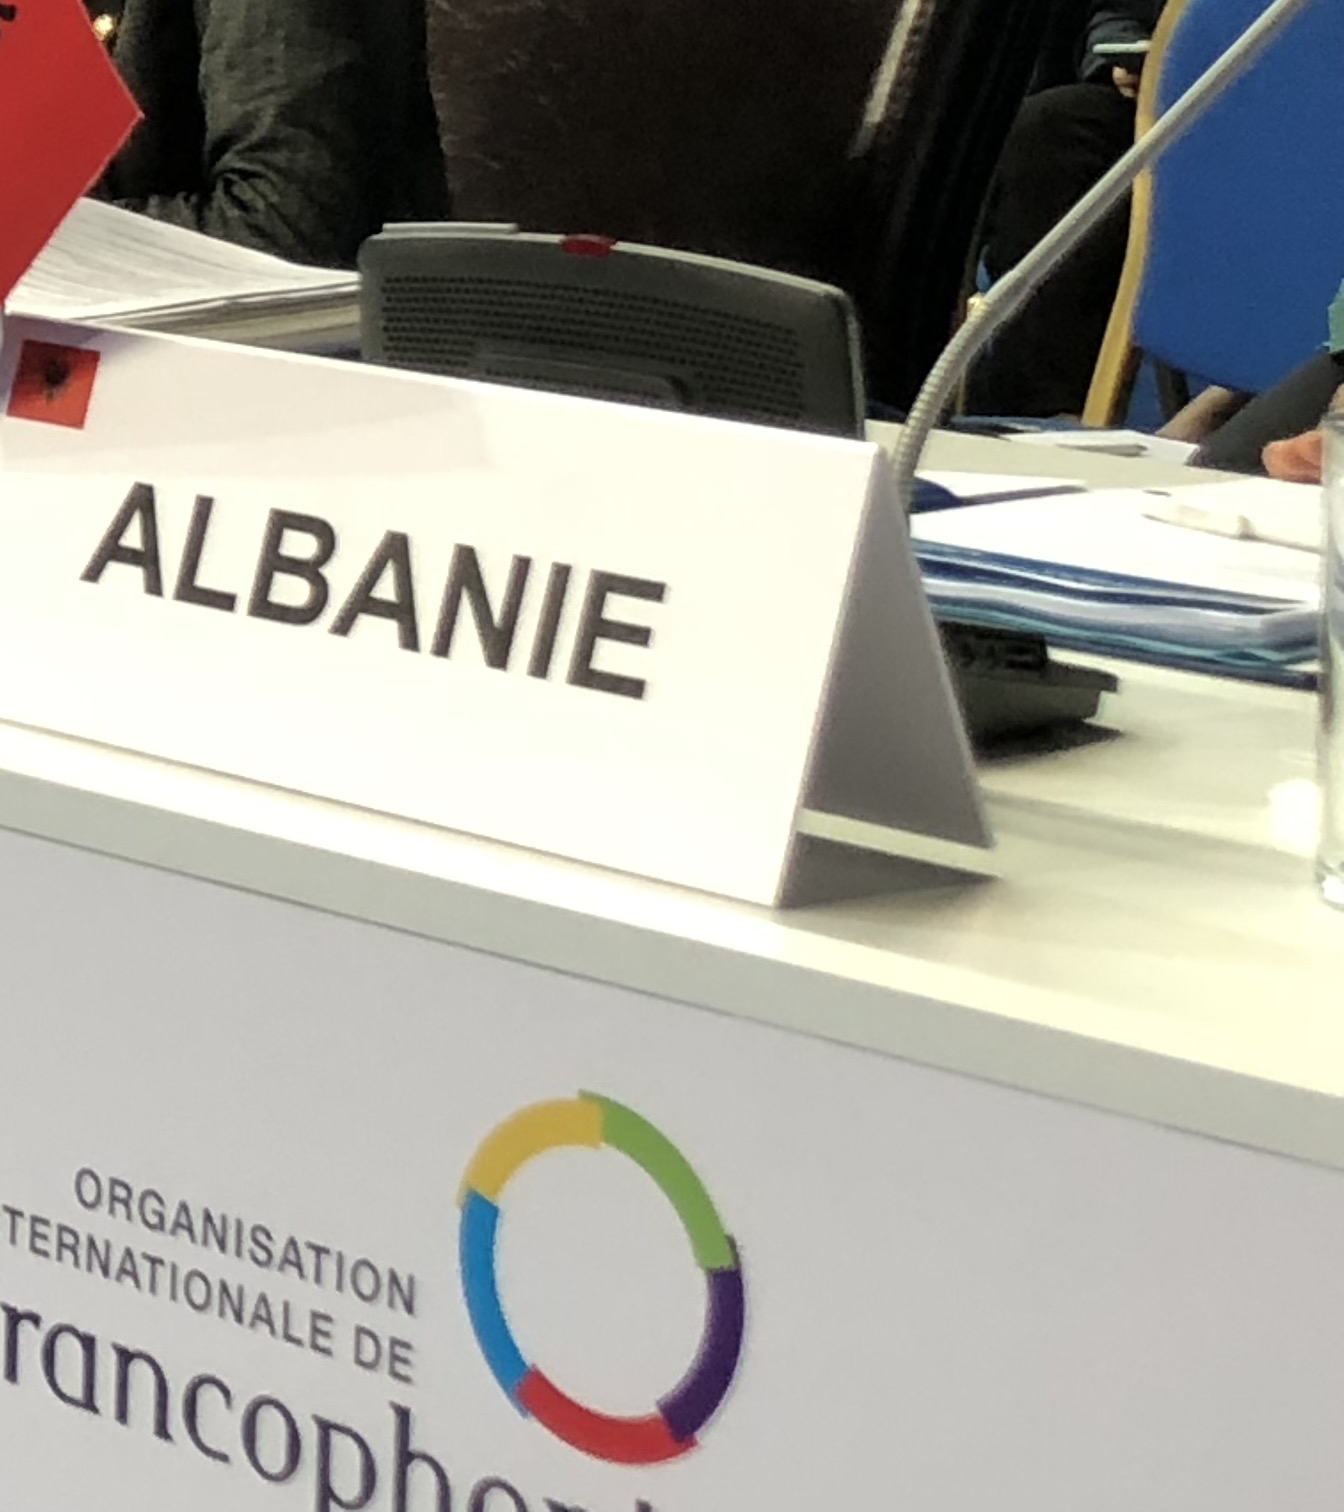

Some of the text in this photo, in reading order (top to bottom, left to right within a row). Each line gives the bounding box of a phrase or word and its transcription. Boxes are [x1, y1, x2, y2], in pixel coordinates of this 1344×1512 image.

[79, 481, 670, 701] ALBANIE
[74, 1167, 418, 1317] ORGANISATION
[353, 1325, 416, 1386] DE
